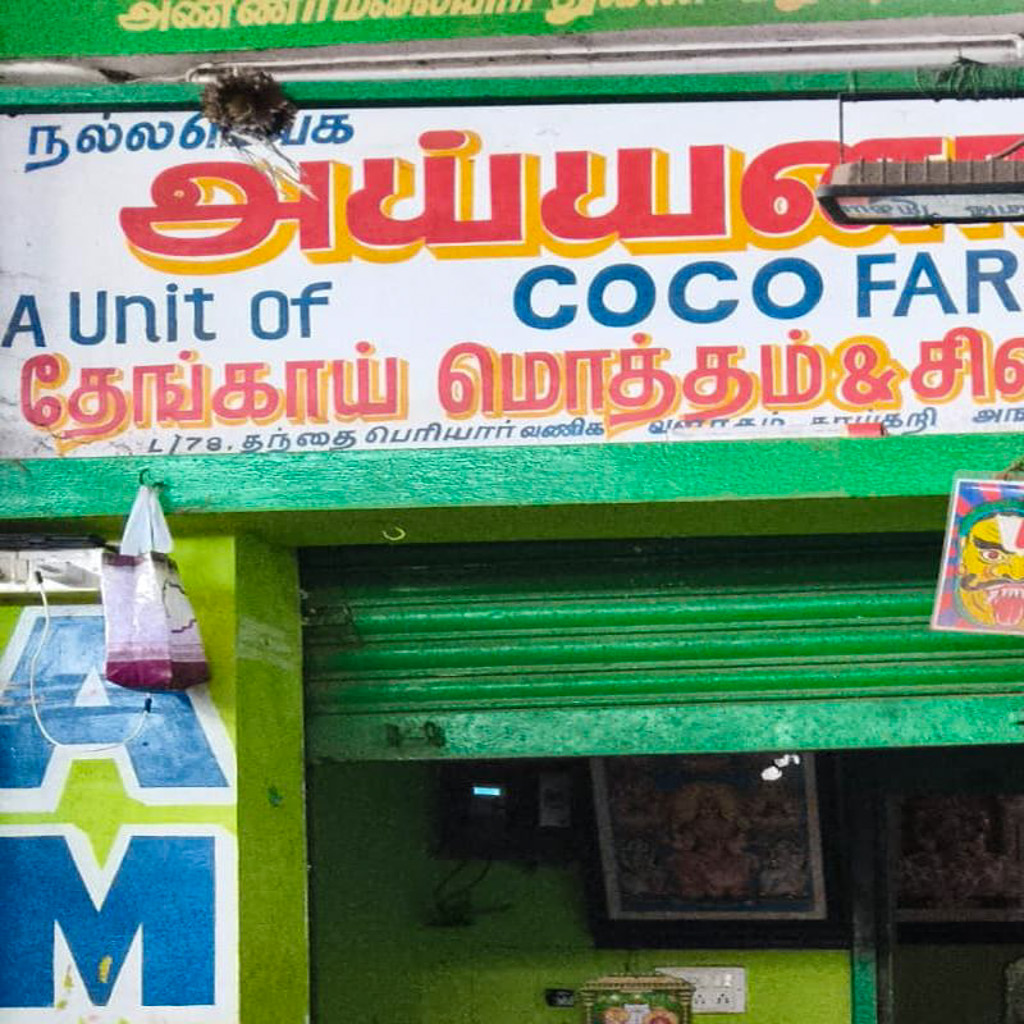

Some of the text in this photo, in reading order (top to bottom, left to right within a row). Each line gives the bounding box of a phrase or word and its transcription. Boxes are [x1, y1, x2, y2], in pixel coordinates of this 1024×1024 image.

[1, 293, 46, 348] A
[69, 282, 215, 346] Unit
[512, 255, 825, 330] COCO
[20, 340, 412, 454] தேங்காய்
